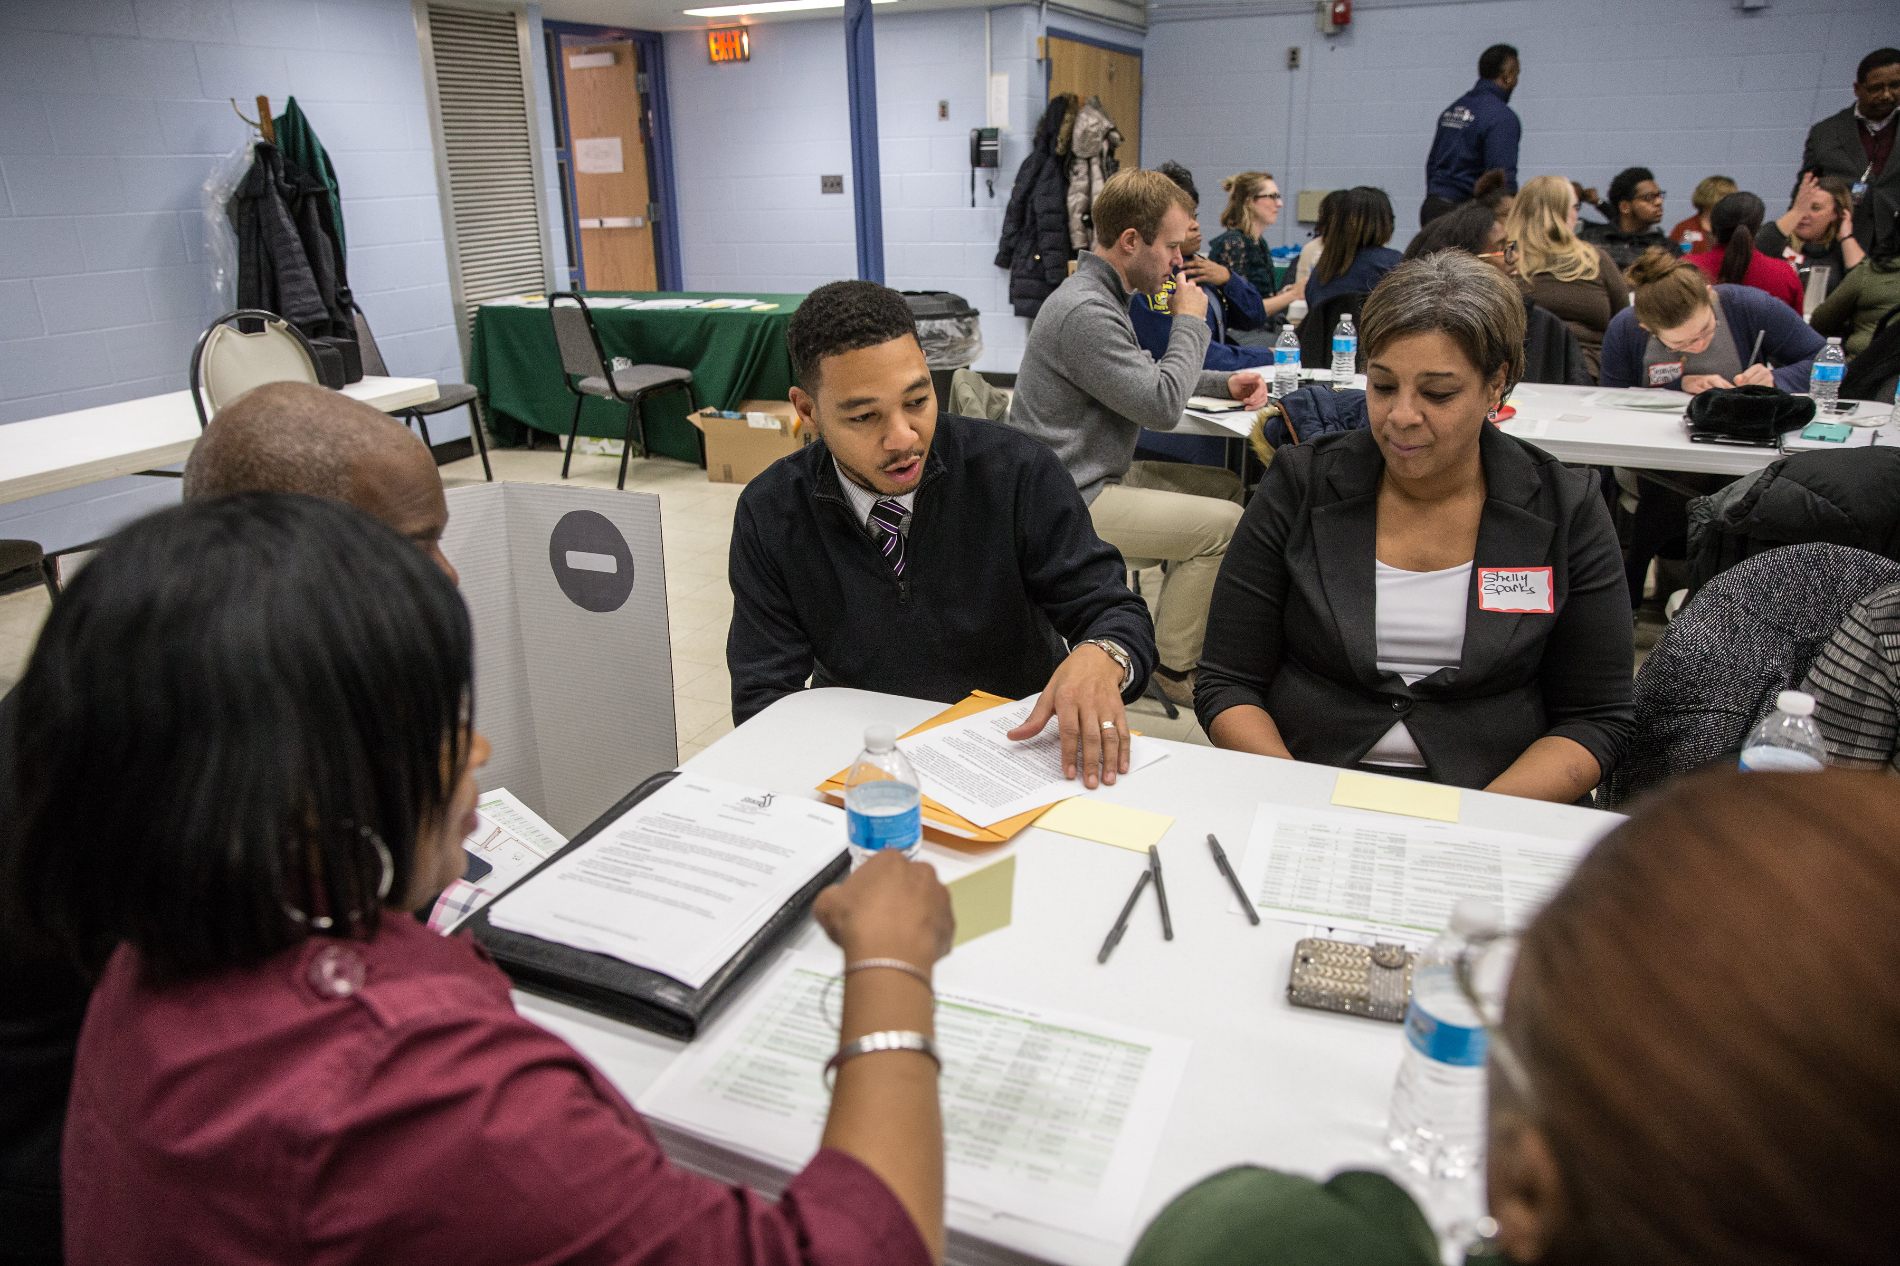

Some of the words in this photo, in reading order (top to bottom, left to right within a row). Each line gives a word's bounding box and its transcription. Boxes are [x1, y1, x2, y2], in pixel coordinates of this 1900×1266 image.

[708, 31, 741, 61] EXIT
[1483, 571, 1528, 587] Shelly
[1483, 583, 1536, 595] Sparks
